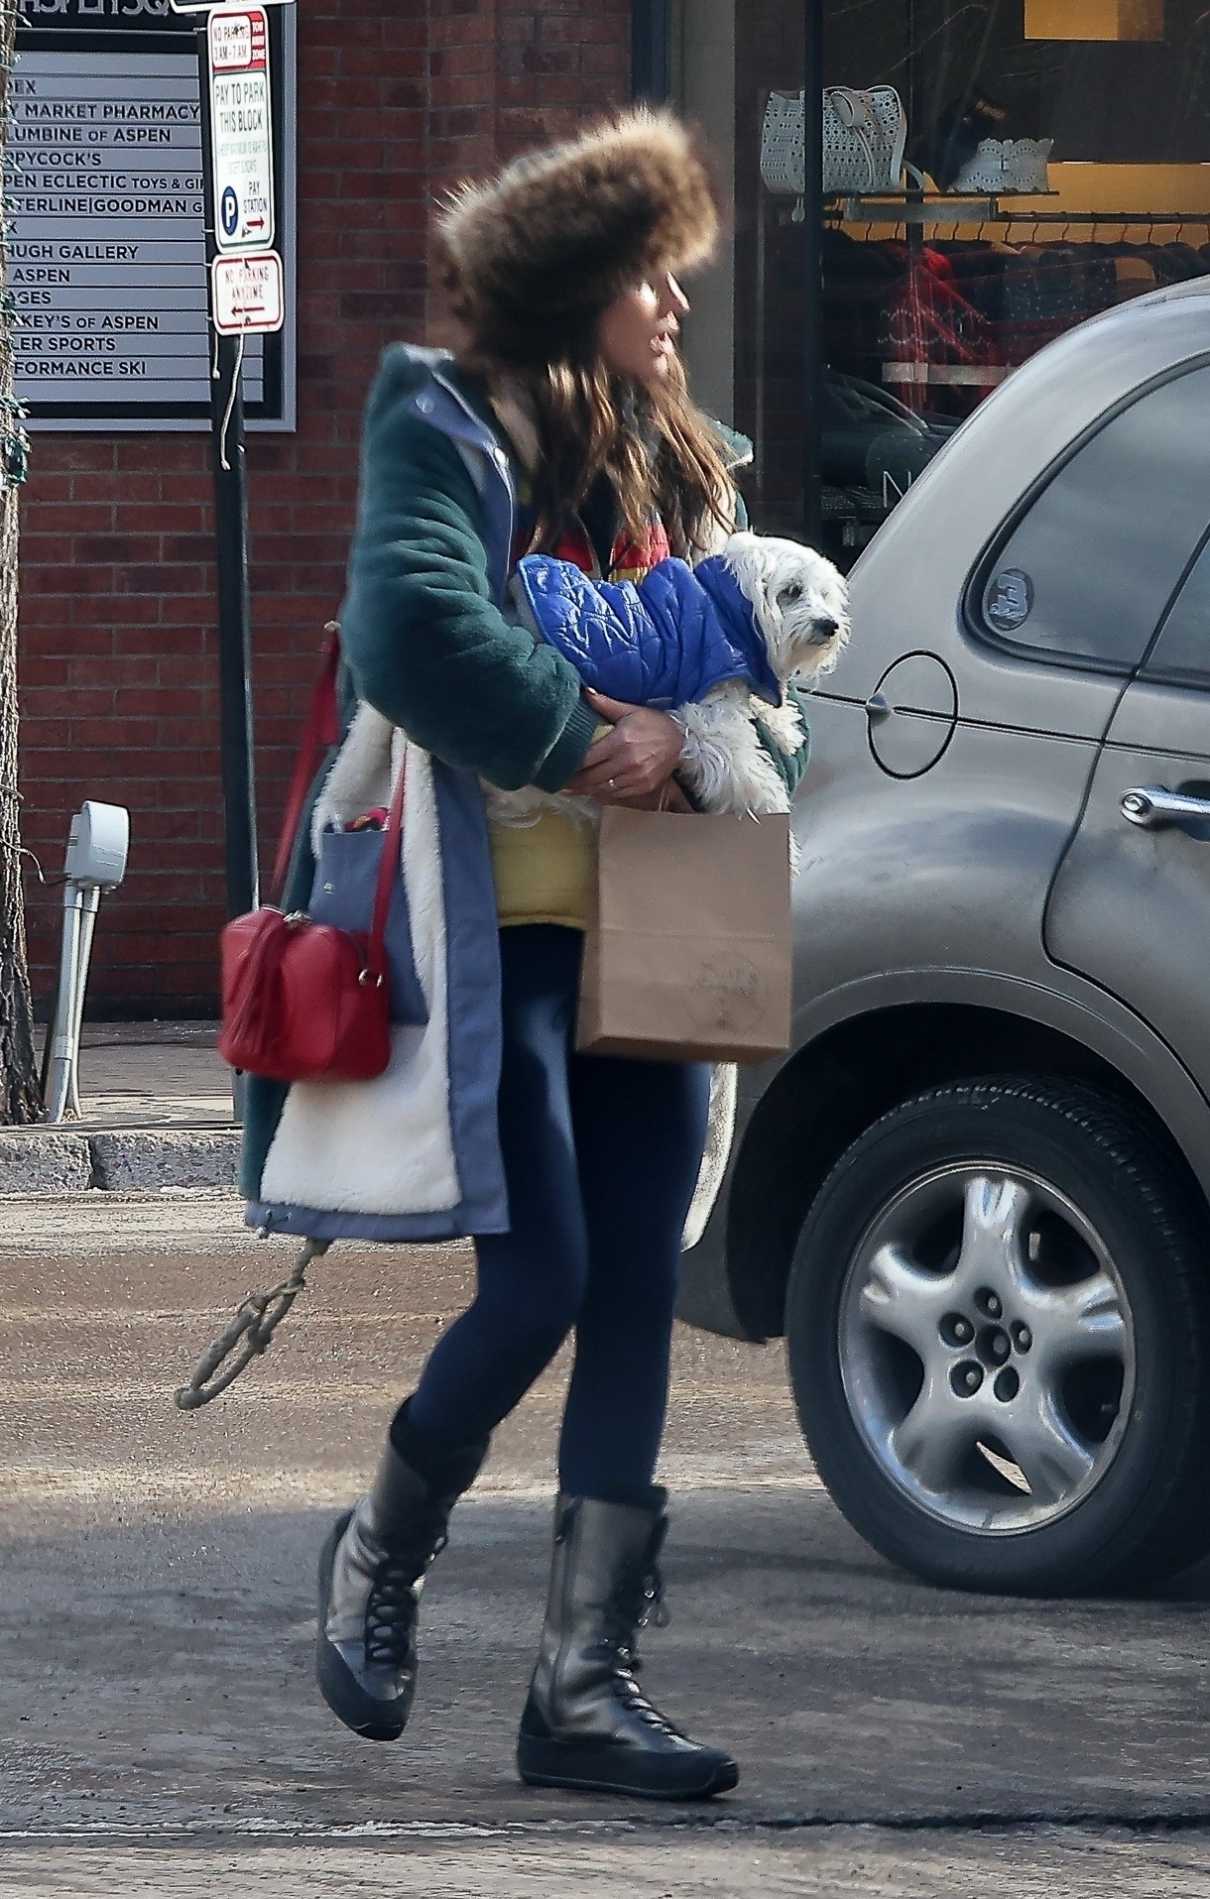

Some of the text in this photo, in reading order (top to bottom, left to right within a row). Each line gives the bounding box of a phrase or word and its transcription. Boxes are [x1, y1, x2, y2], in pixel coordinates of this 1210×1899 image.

[216, 81, 265, 105] PAY TO PARK
[25, 104, 97, 118] MARKET
[103, 105, 200, 119] PHARMACY
[219, 110, 263, 133] THIS BLOCK
[88, 131, 108, 142] OF
[114, 128, 171, 142] ASPEN
[43, 175, 127, 188] ECLECTIC
[132, 178, 168, 189] TOYS
[172, 178, 180, 189] &
[249, 182, 260, 196] PAY
[243, 198, 268, 214] STATION
[59, 246, 138, 259] GALLERY
[13, 269, 70, 282] ASPEN
[76, 317, 96, 328] OF
[101, 315, 158, 329] ASPEN
[48, 338, 116, 351] SPORTS
[119, 362, 146, 375] SKI
